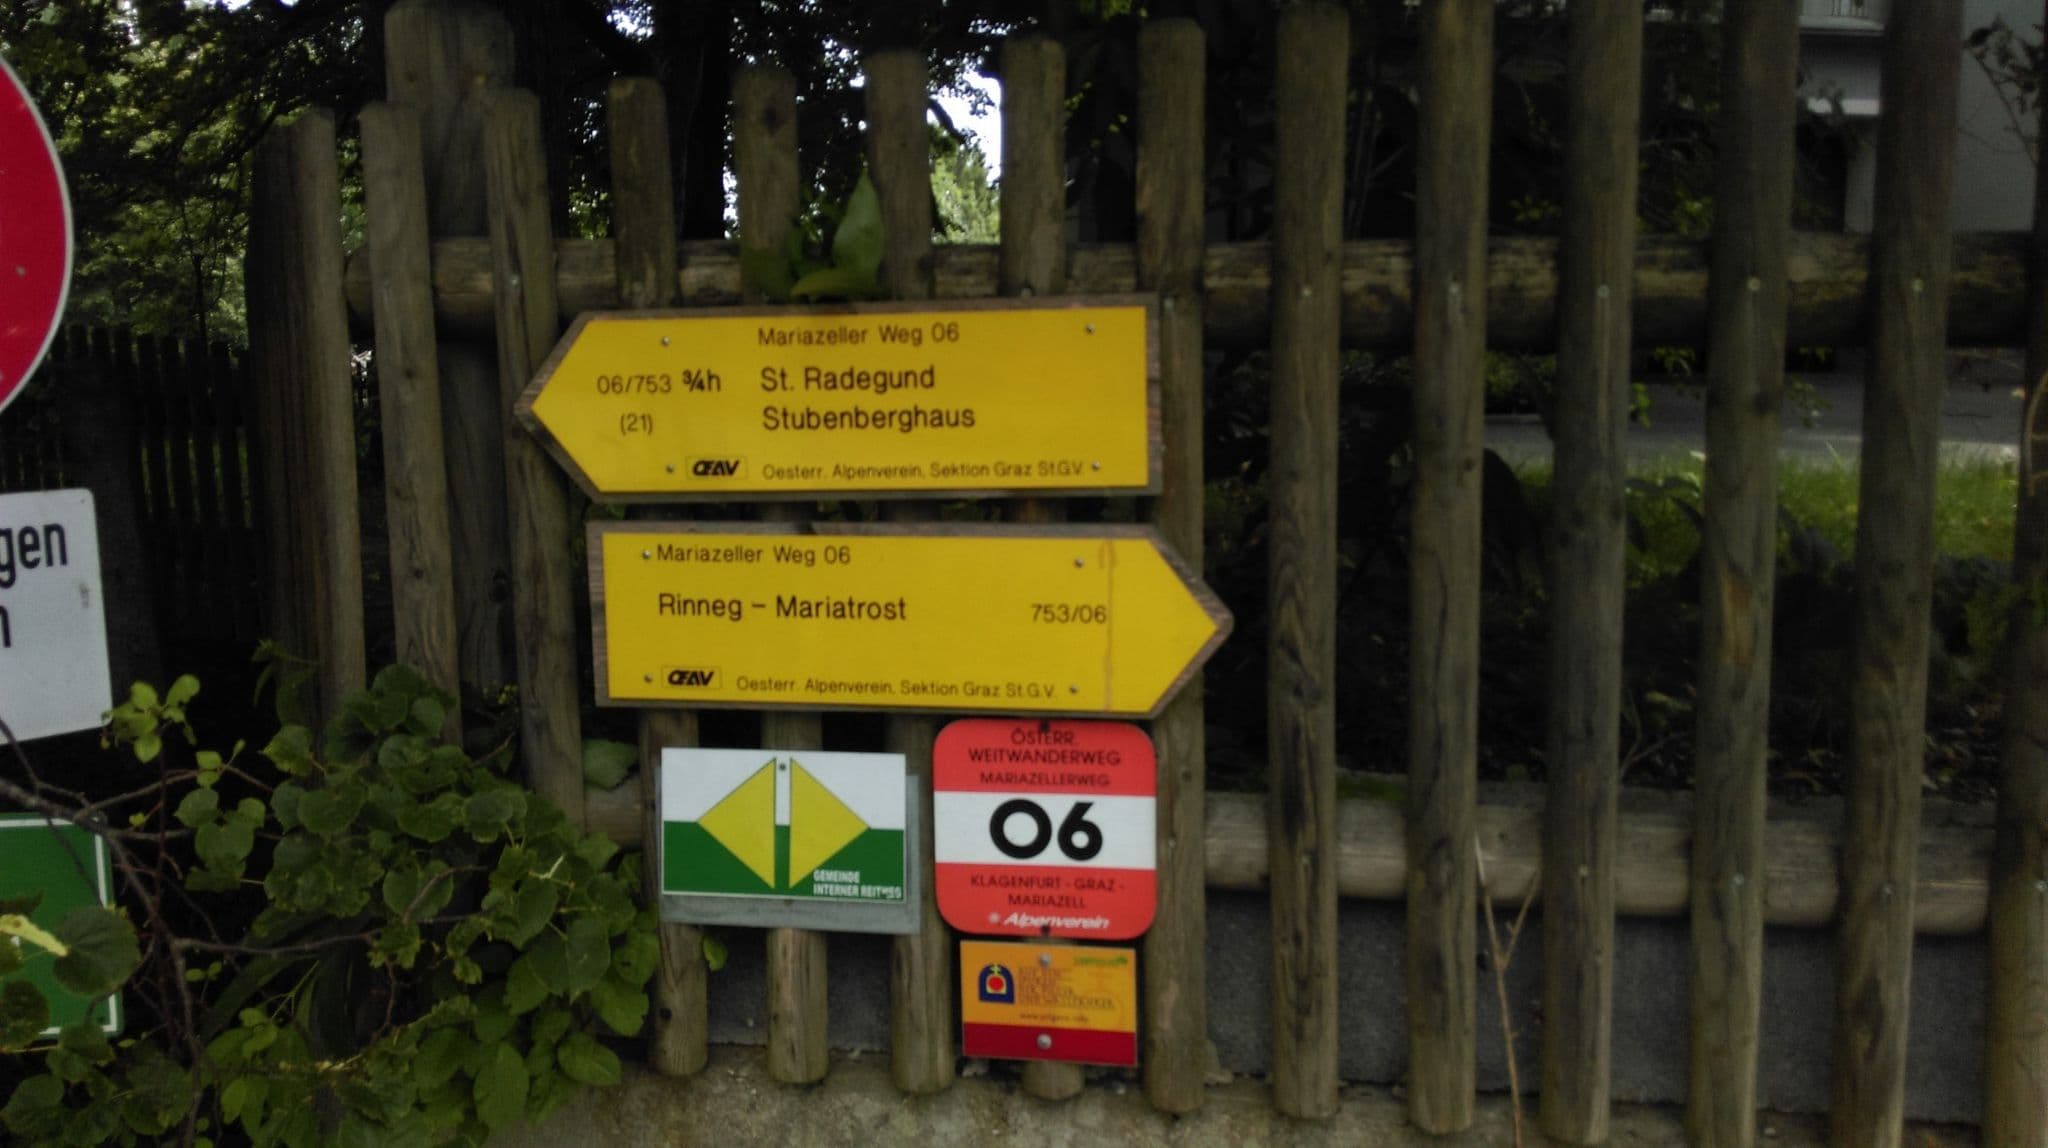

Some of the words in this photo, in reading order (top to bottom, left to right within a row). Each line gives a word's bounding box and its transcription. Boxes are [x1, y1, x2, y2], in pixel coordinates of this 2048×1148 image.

[757, 325, 868, 347] Mariazeller
[878, 324, 922, 346] Weg
[931, 323, 960, 343] 06
[596, 374, 673, 395] 06/753
[760, 368, 796, 392] St.
[803, 365, 936, 392] Radegund
[619, 412, 654, 435] (21)
[762, 406, 976, 433] Stubenberghaus
[930, 461, 989, 478] Sektion
[994, 460, 1033, 477] Graz
[656, 544, 765, 564] Mariazeller
[773, 546, 817, 567] Weg
[824, 546, 851, 564] 06
[658, 593, 743, 622] Rinneg
[775, 596, 907, 622] Mariatrost
[1031, 603, 1107, 625] 753/06
[900, 681, 958, 697] Sektion
[962, 681, 1000, 699] Graz
[968, 750, 1121, 766] WEITWANDERWEG
[980, 772, 1111, 787] MARIAZELLERWEG
[990, 799, 1103, 862] 06
[814, 870, 860, 883] GEMEINDE
[970, 874, 1061, 890] KLAGENFURT
[1074, 878, 1116, 893] GRAZ
[813, 883, 859, 897] INTERNER
[1007, 893, 1086, 909] MARIAZELL
[1004, 912, 1111, 930] Alpenverein
